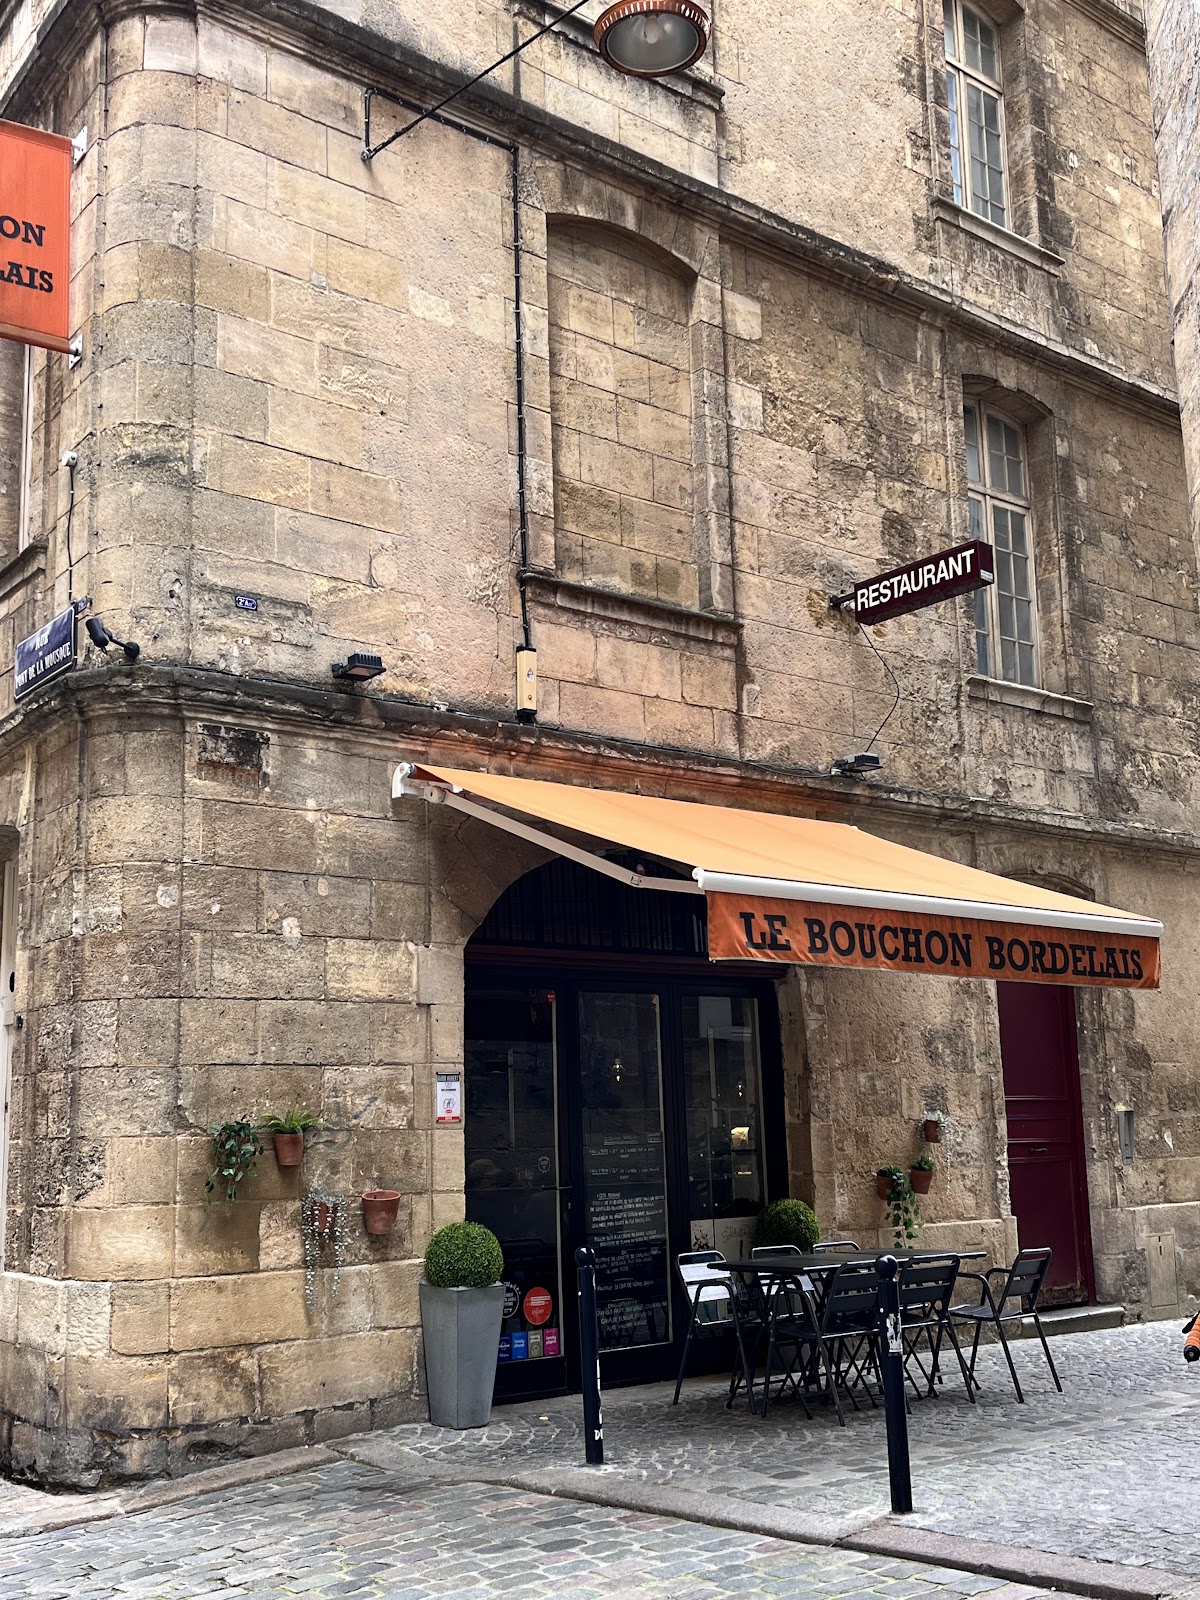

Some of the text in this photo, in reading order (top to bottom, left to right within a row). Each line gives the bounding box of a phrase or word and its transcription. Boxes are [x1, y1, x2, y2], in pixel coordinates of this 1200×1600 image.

[856, 548, 975, 612] RESTAURANT
[15, 641, 71, 689] PONT DE LA MOUSQUE
[35, 631, 49, 651] RUE
[739, 911, 1144, 981] LE BOUCHON BORDELAIS
